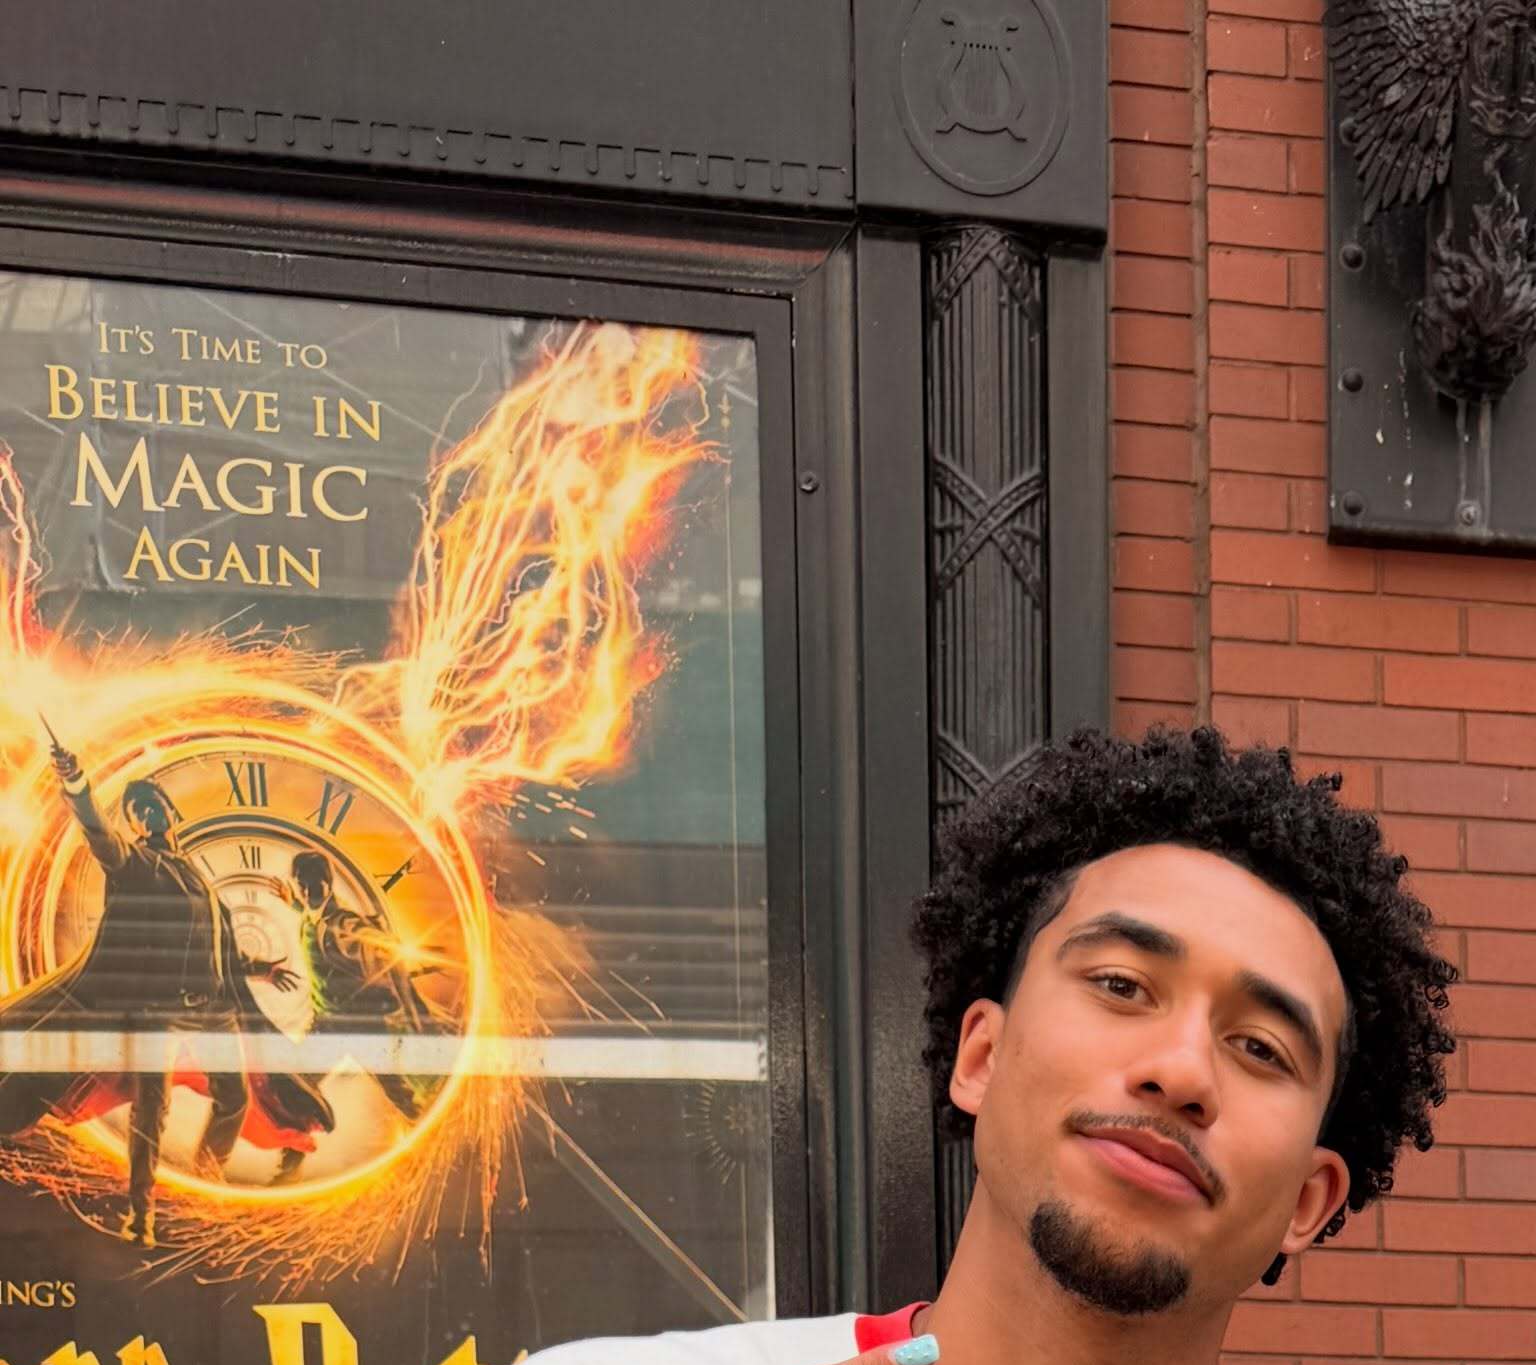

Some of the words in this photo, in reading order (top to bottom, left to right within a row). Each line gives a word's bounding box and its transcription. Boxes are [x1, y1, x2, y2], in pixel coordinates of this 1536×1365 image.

[97, 321, 155, 355] IT'S
[171, 327, 262, 364] TIME
[277, 342, 328, 369] TO
[44, 364, 280, 433] BELIEVE
[311, 396, 382, 441] IN
[70, 431, 368, 521] MAGIC
[123, 525, 321, 589] AGAIN
